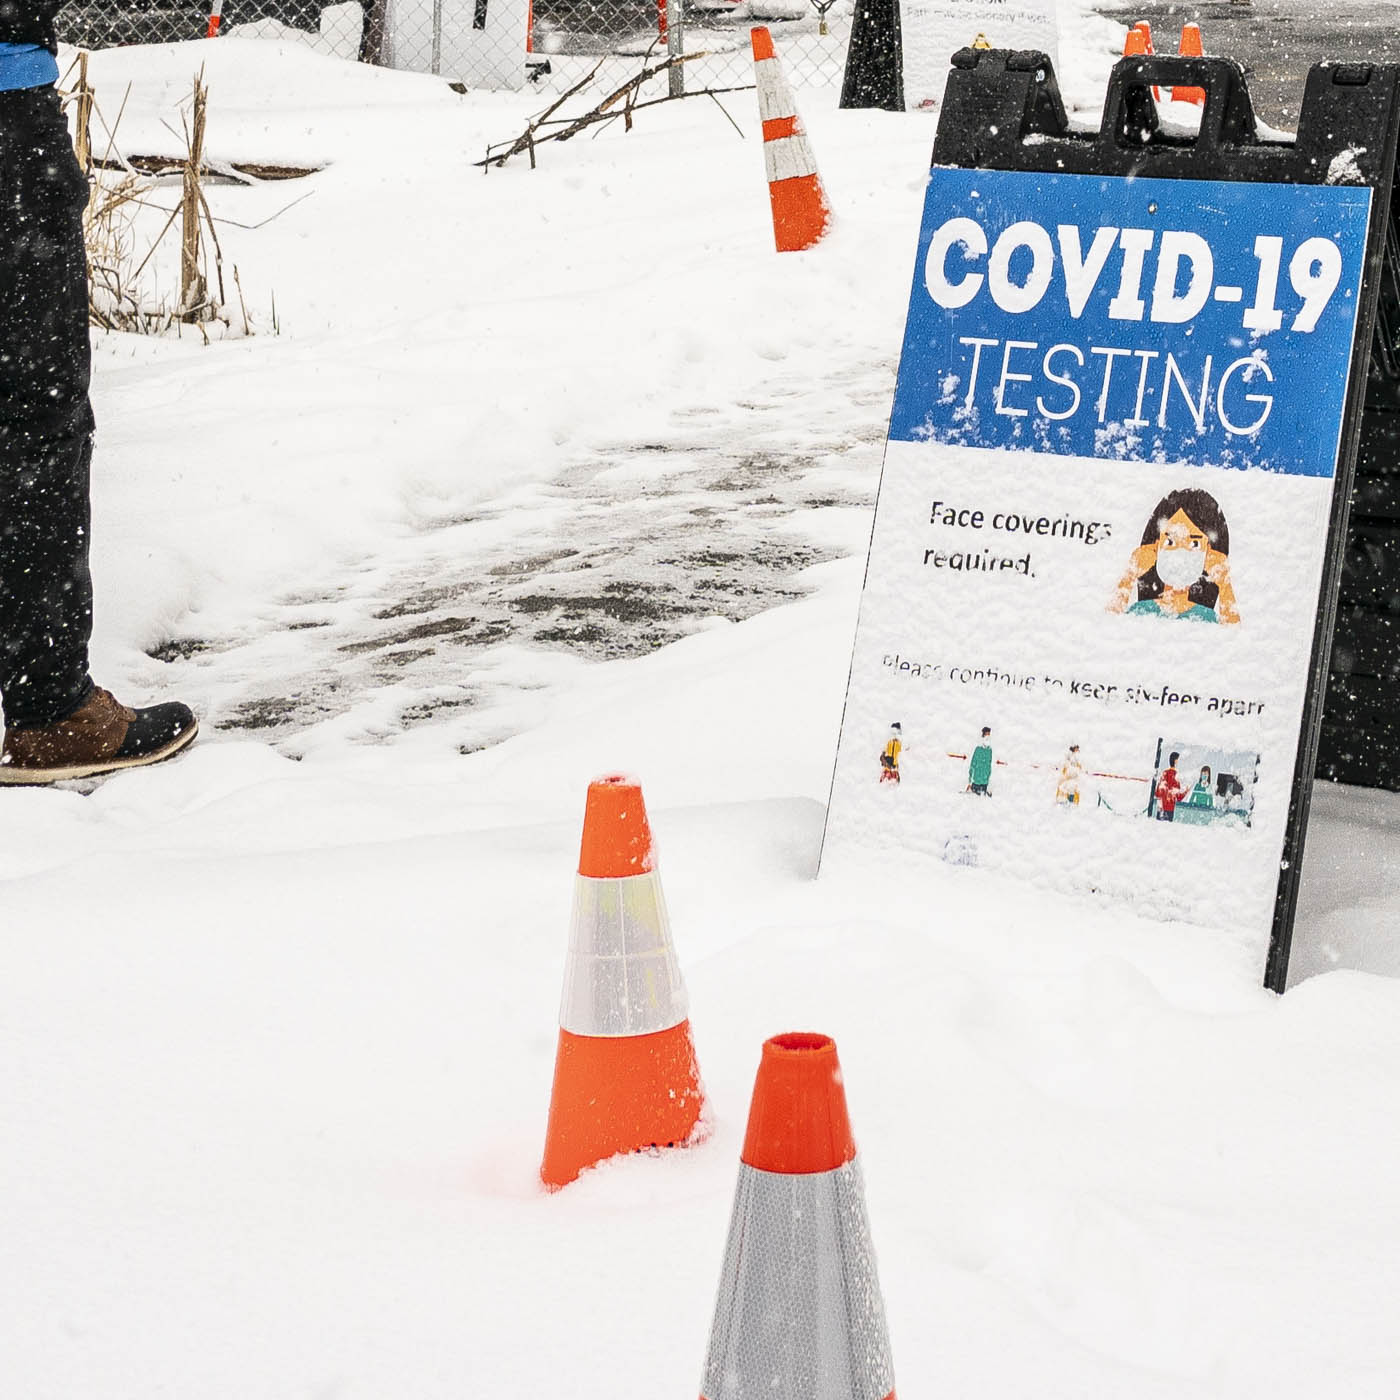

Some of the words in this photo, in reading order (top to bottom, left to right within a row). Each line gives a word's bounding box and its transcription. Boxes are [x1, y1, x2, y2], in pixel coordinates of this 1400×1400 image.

[924, 217, 1342, 332] COVID-19
[959, 337, 1275, 435] TESTING
[930, 501, 984, 529] Face
[992, 511, 1112, 546] coverings
[923, 546, 1036, 579] required.
